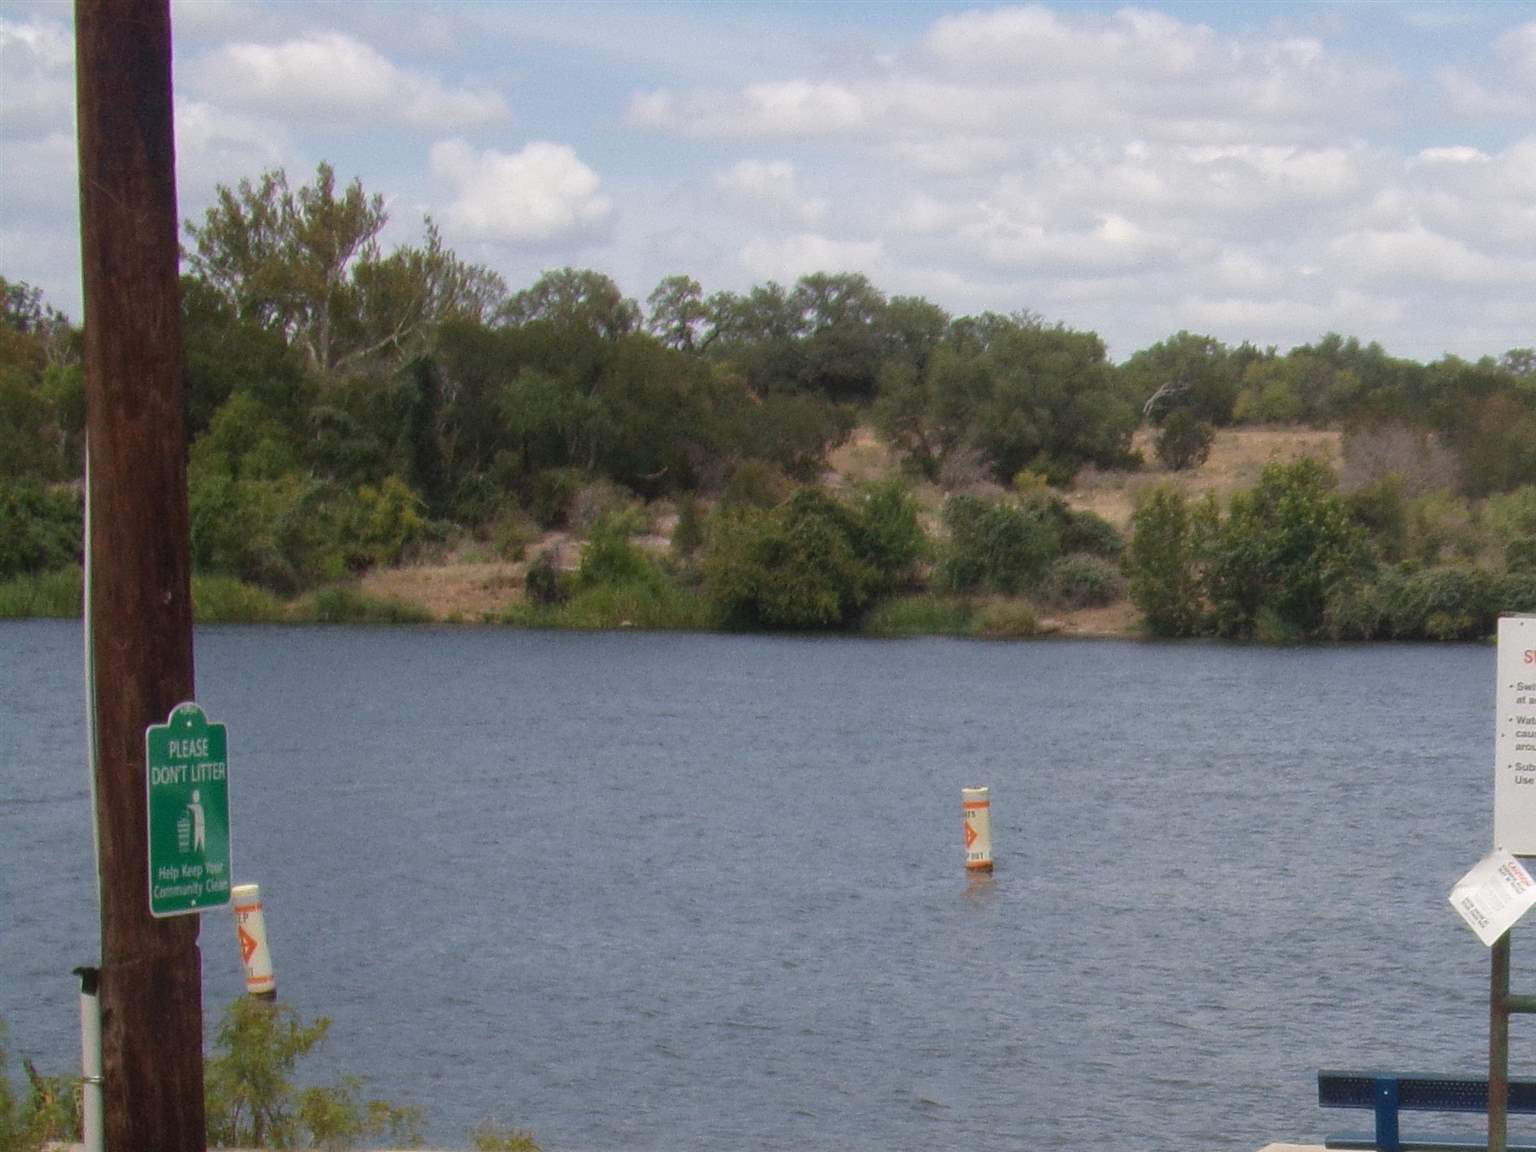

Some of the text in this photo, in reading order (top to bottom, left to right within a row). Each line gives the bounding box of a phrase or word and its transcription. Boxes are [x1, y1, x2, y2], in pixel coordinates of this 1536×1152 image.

[1516, 696, 1526, 704] at
[169, 739, 208, 758] PLEASE
[152, 762, 226, 785] DON'T LITTER
[1514, 775, 1535, 785] Use
[158, 866, 179, 882] Help
[182, 864, 203, 880] Keep
[154, 882, 203, 898] Community
